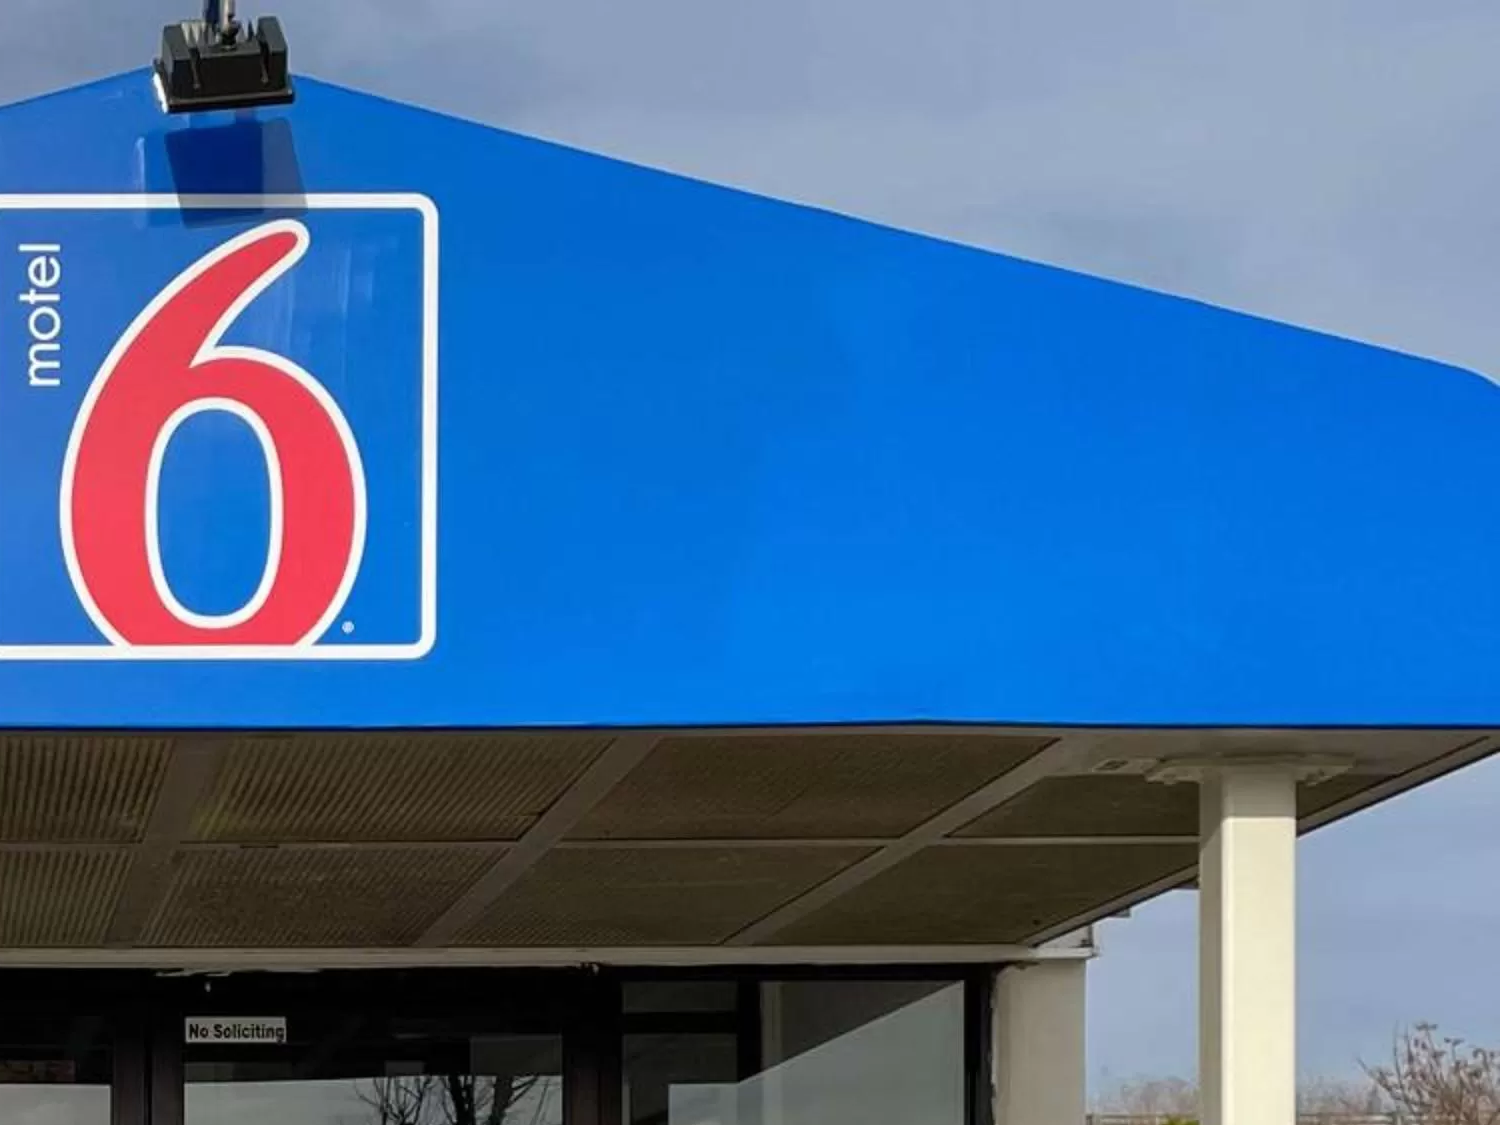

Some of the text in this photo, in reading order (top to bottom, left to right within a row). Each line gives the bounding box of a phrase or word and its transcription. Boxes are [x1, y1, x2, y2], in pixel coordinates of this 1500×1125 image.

[18, 243, 61, 387] motel
[59, 218, 368, 646] 6
[189, 1023, 285, 1044] No Soliciting
